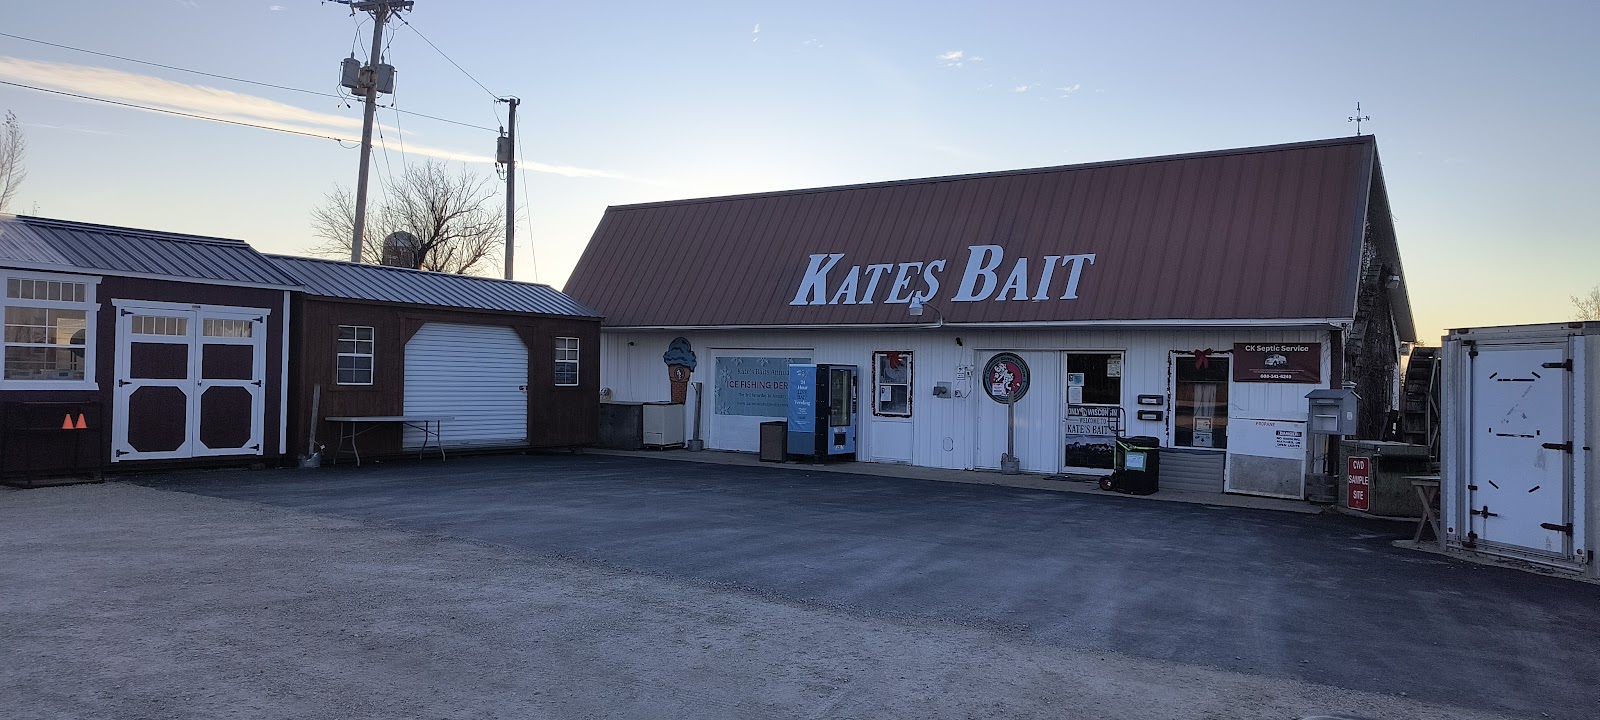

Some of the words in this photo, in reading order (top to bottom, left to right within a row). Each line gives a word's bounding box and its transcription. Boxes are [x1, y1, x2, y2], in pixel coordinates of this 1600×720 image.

[789, 253, 947, 306] KATES
[951, 244, 1096, 303] BAIT
[1256, 345, 1280, 353] Septic
[740, 380, 771, 389] FISHING
[774, 382, 788, 390] DER
[1067, 424, 1090, 433] KATE'S
[1353, 460, 1364, 470] CWD
[1348, 474, 1369, 486] SAMPLE
[1353, 490, 1364, 500] SITE
